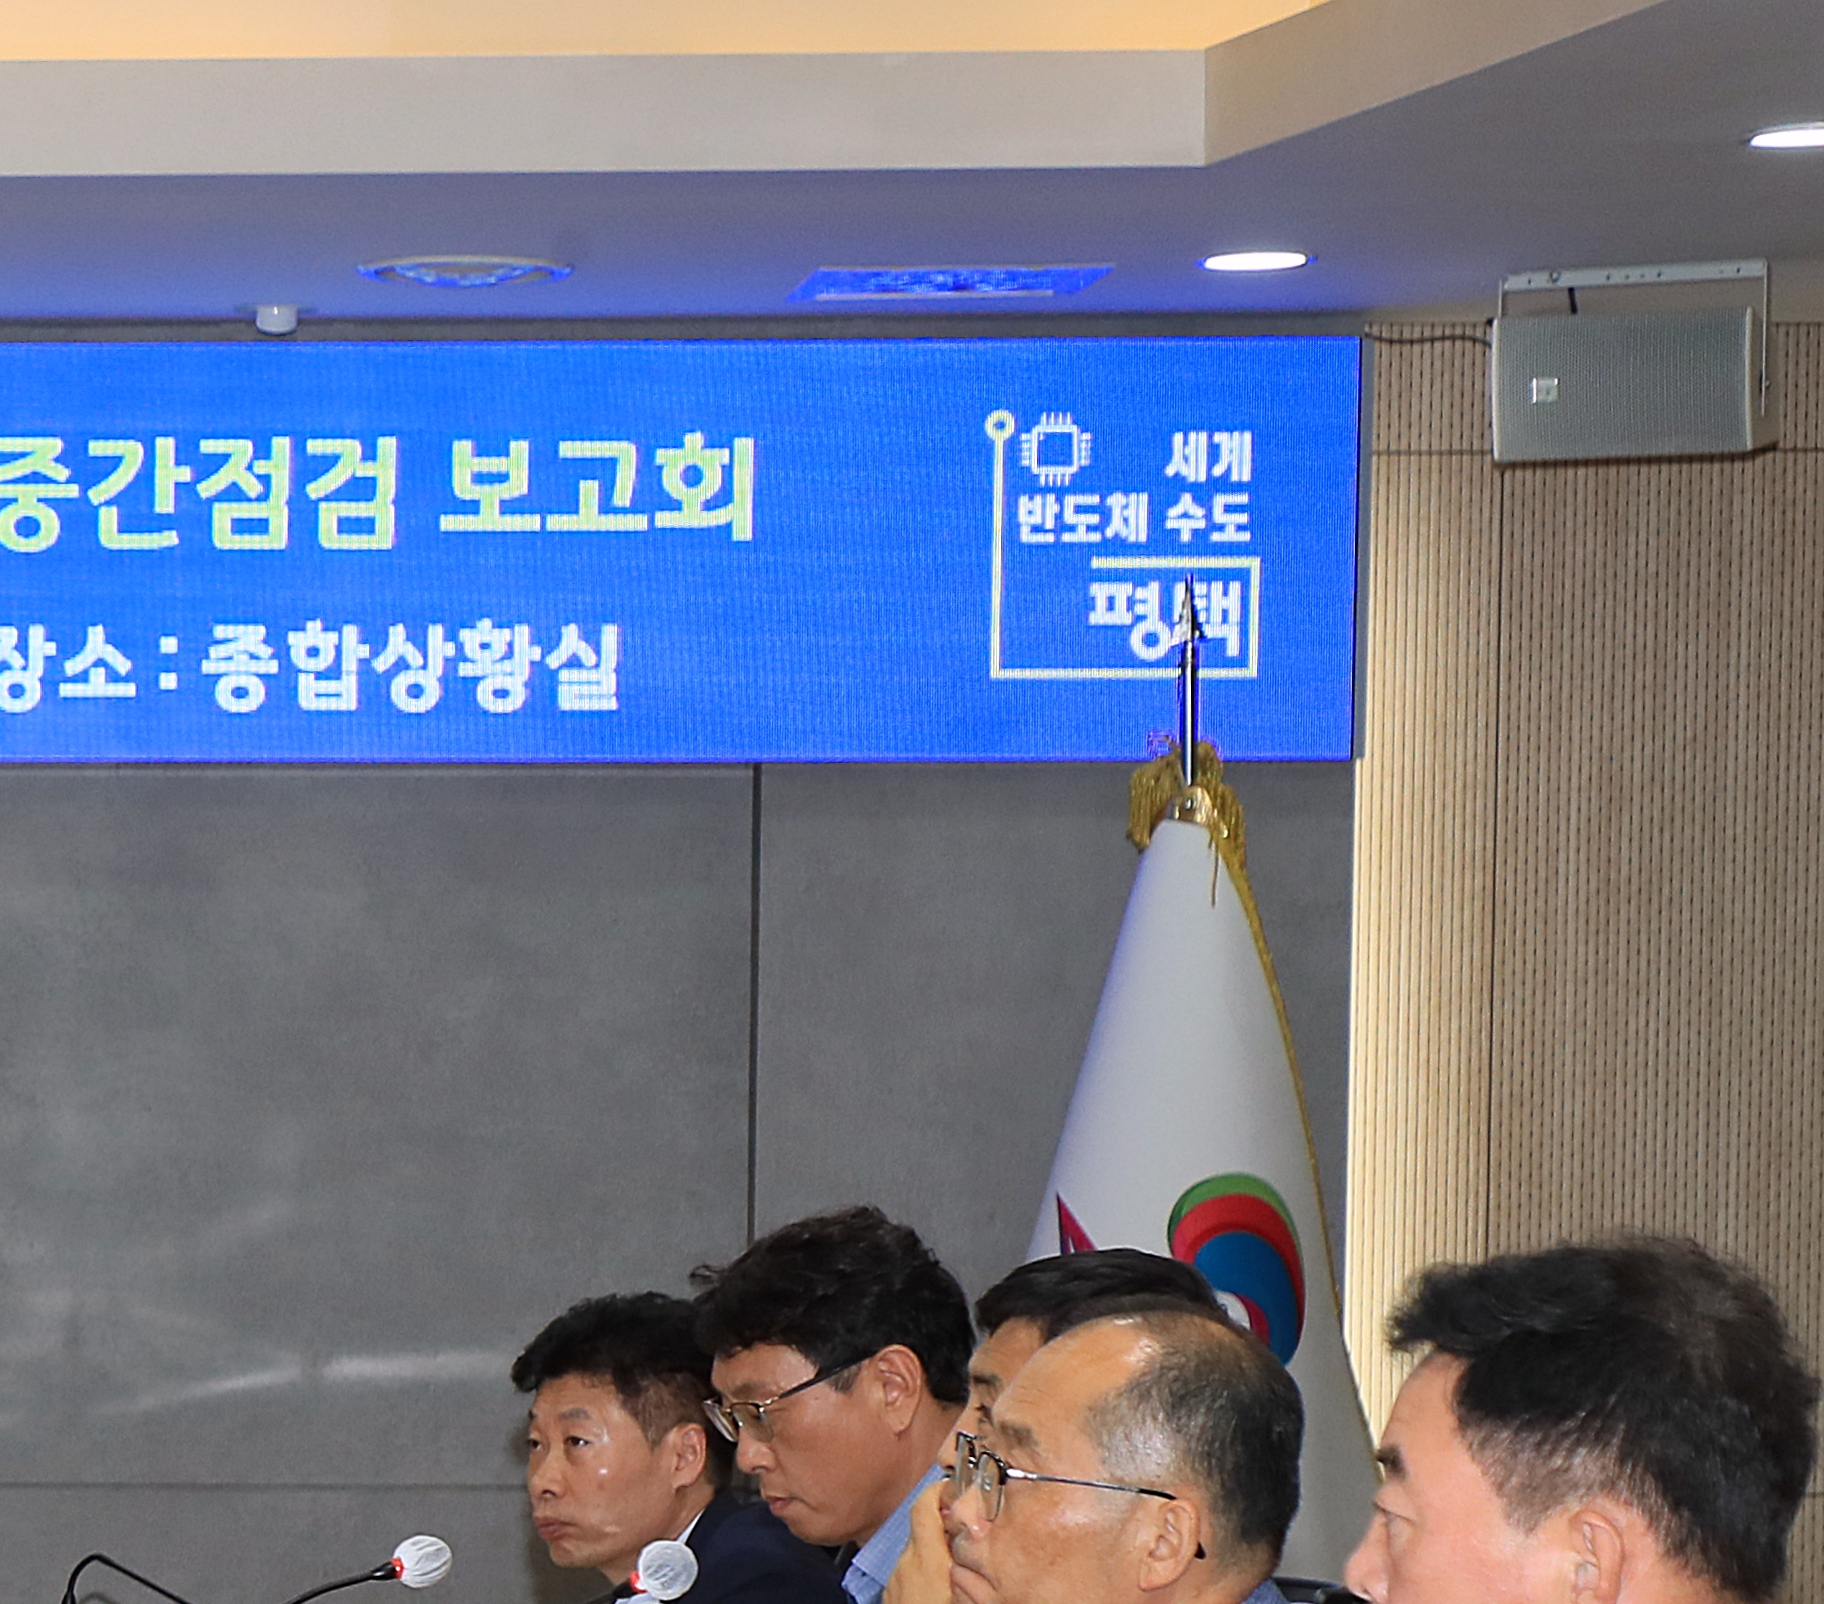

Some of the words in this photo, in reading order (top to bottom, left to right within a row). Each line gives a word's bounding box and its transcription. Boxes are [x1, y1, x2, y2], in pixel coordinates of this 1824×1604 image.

[439, 430, 756, 543] 보고회
[1165, 430, 1252, 482] 세계
[1017, 491, 1148, 543] 반도체
[1165, 491, 1251, 543] 수도
[1088, 580, 1241, 661] 평택
[200, 616, 620, 714] 종합상황실
